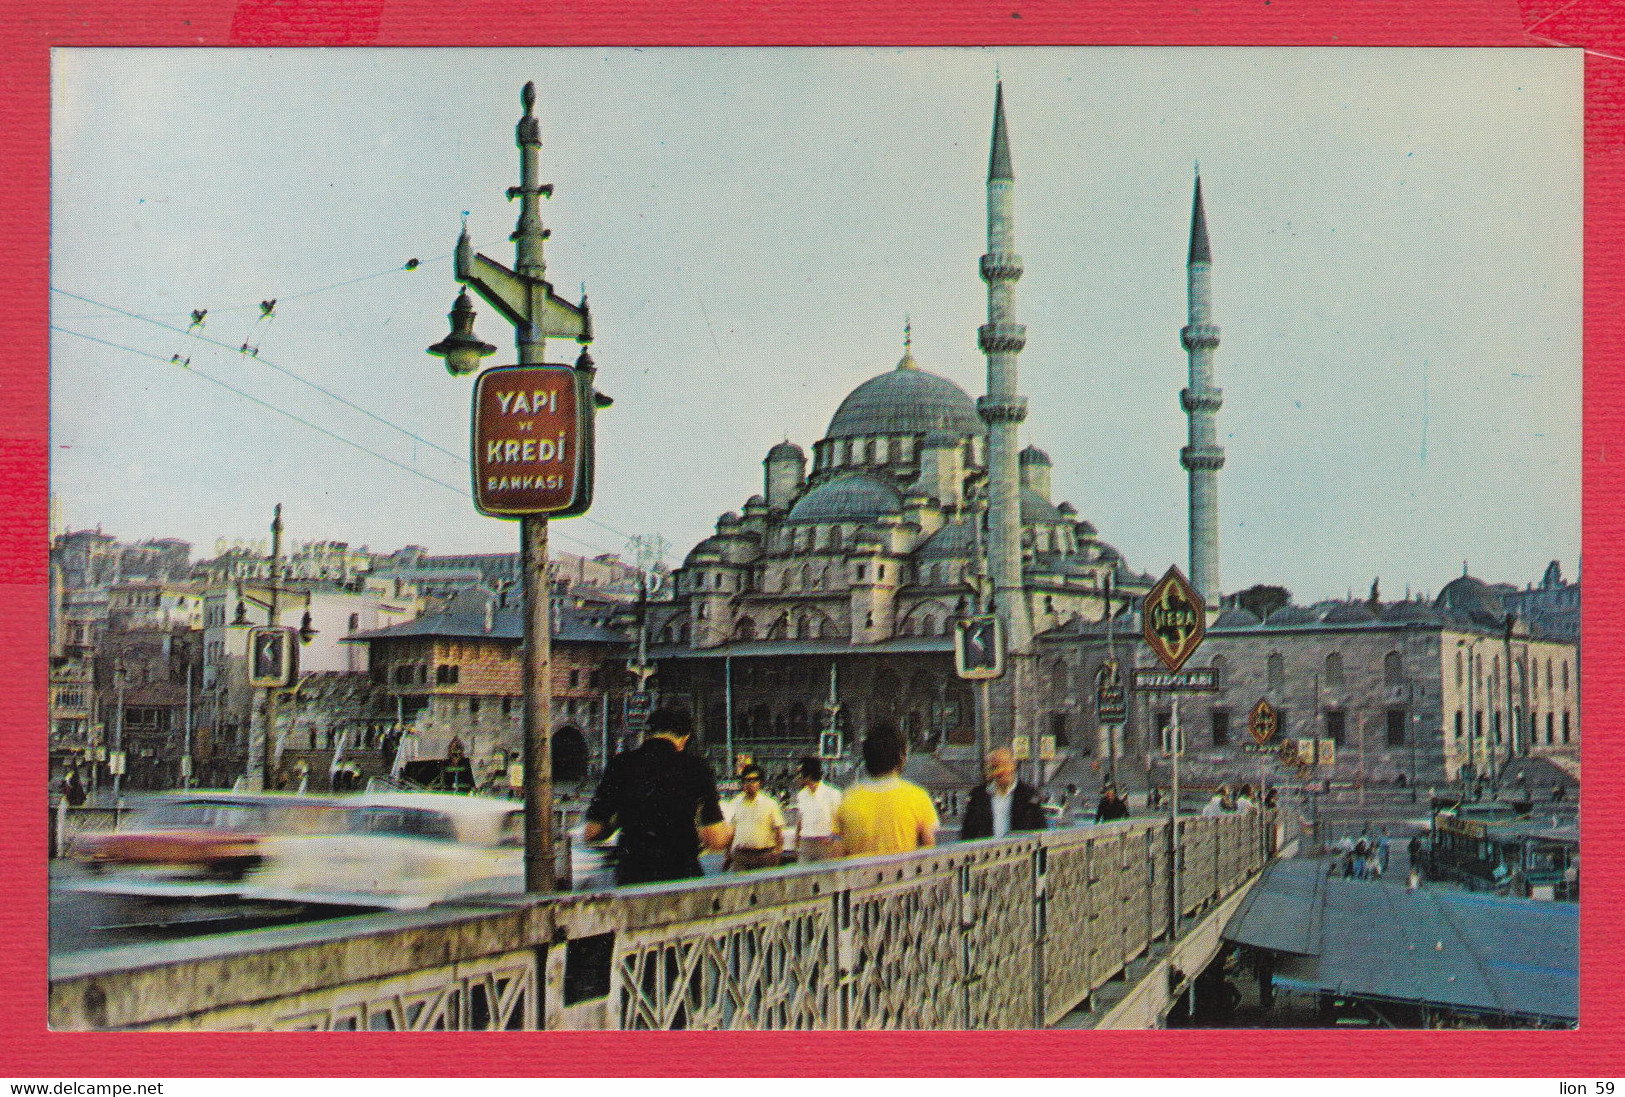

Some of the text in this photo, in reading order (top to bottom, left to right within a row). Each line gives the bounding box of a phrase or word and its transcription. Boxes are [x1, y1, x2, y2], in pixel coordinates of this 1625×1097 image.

[496, 390, 557, 413] YAPI
[487, 431, 566, 463] KREDİ
[488, 475, 564, 491] BANKASI
